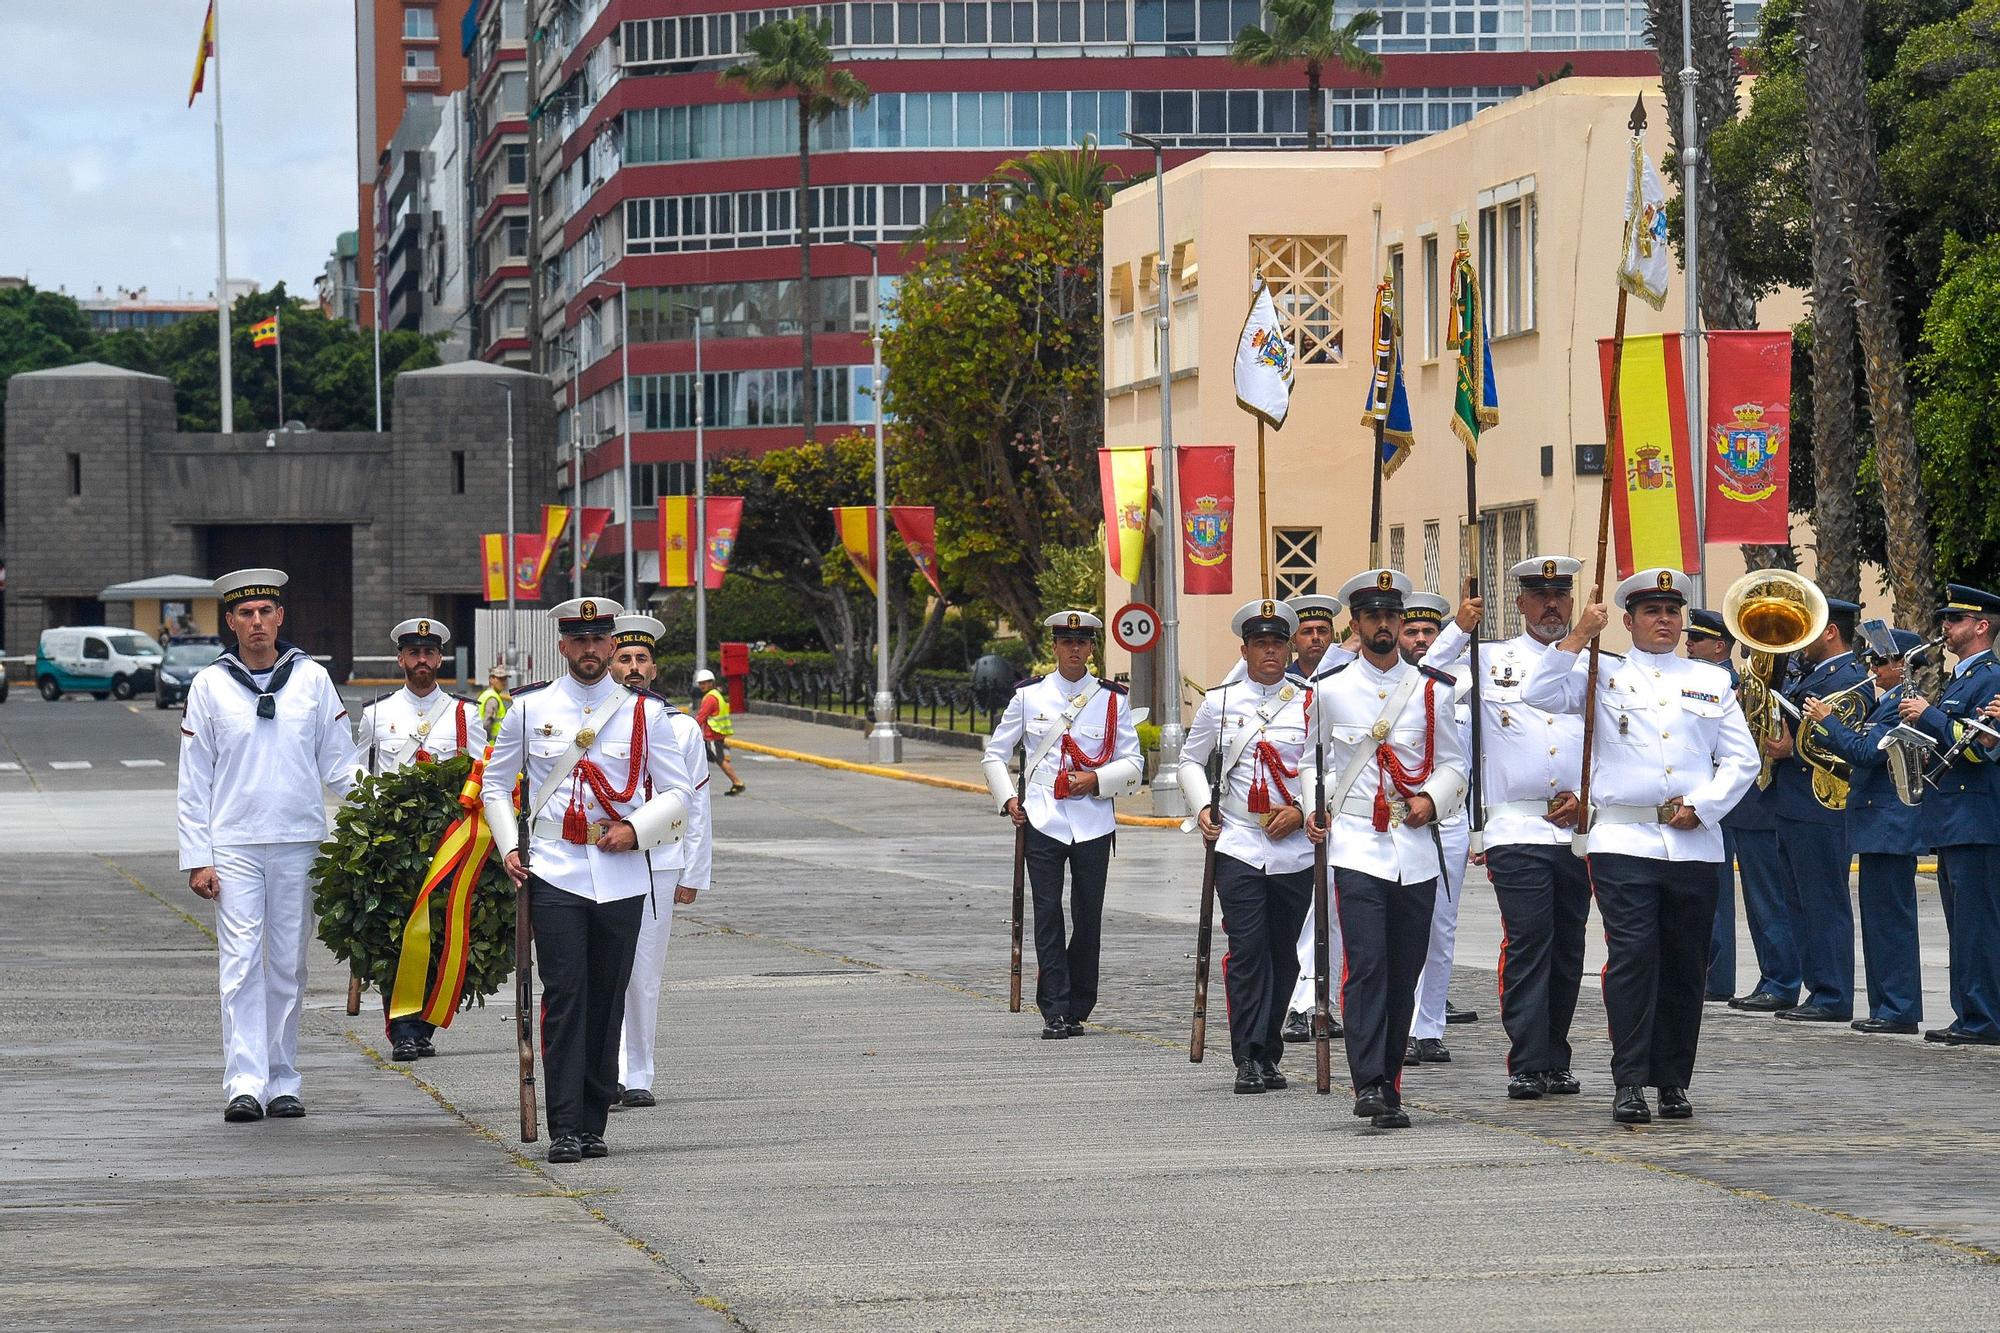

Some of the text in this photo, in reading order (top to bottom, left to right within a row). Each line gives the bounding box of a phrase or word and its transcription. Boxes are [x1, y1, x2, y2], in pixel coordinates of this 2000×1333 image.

[244, 588, 255, 596] DE
[256, 587, 271, 595] LAS
[1406, 610, 1416, 619] DE
[1417, 610, 1430, 618] LAS
[1122, 619, 1150, 637] 30
[623, 634, 634, 642] DE
[634, 634, 647, 642] LAS
